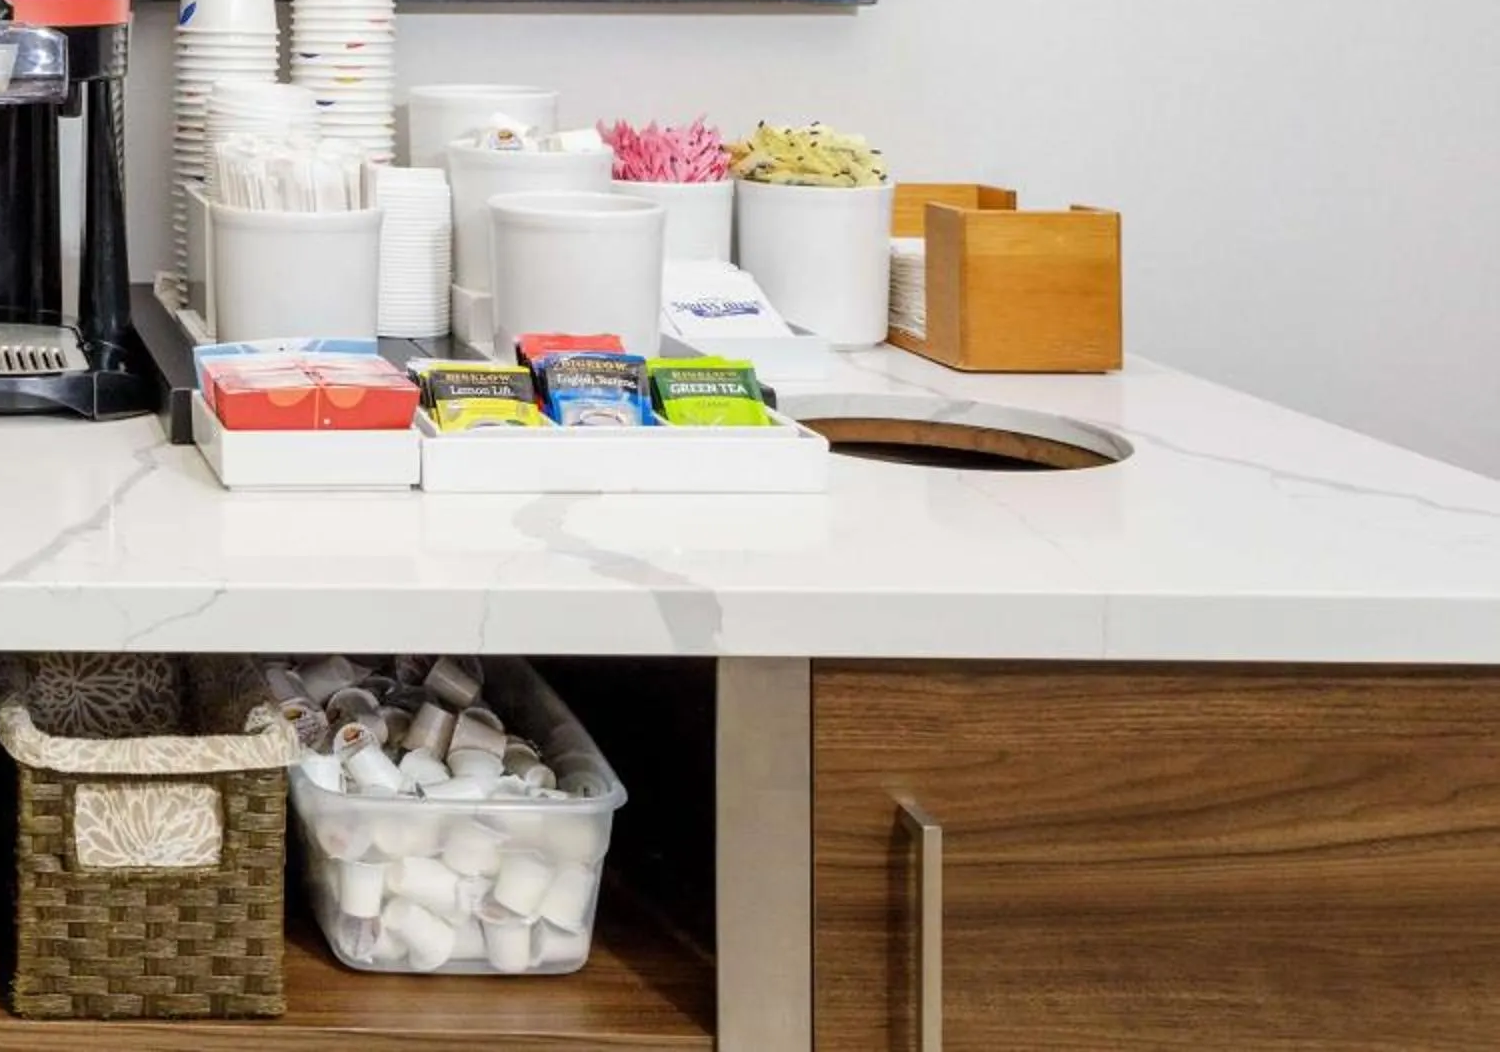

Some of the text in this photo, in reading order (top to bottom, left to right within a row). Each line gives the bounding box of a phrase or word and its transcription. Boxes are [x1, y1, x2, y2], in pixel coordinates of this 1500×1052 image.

[449, 385, 490, 397] Lemon
[670, 382, 749, 395] GREEN TEA
